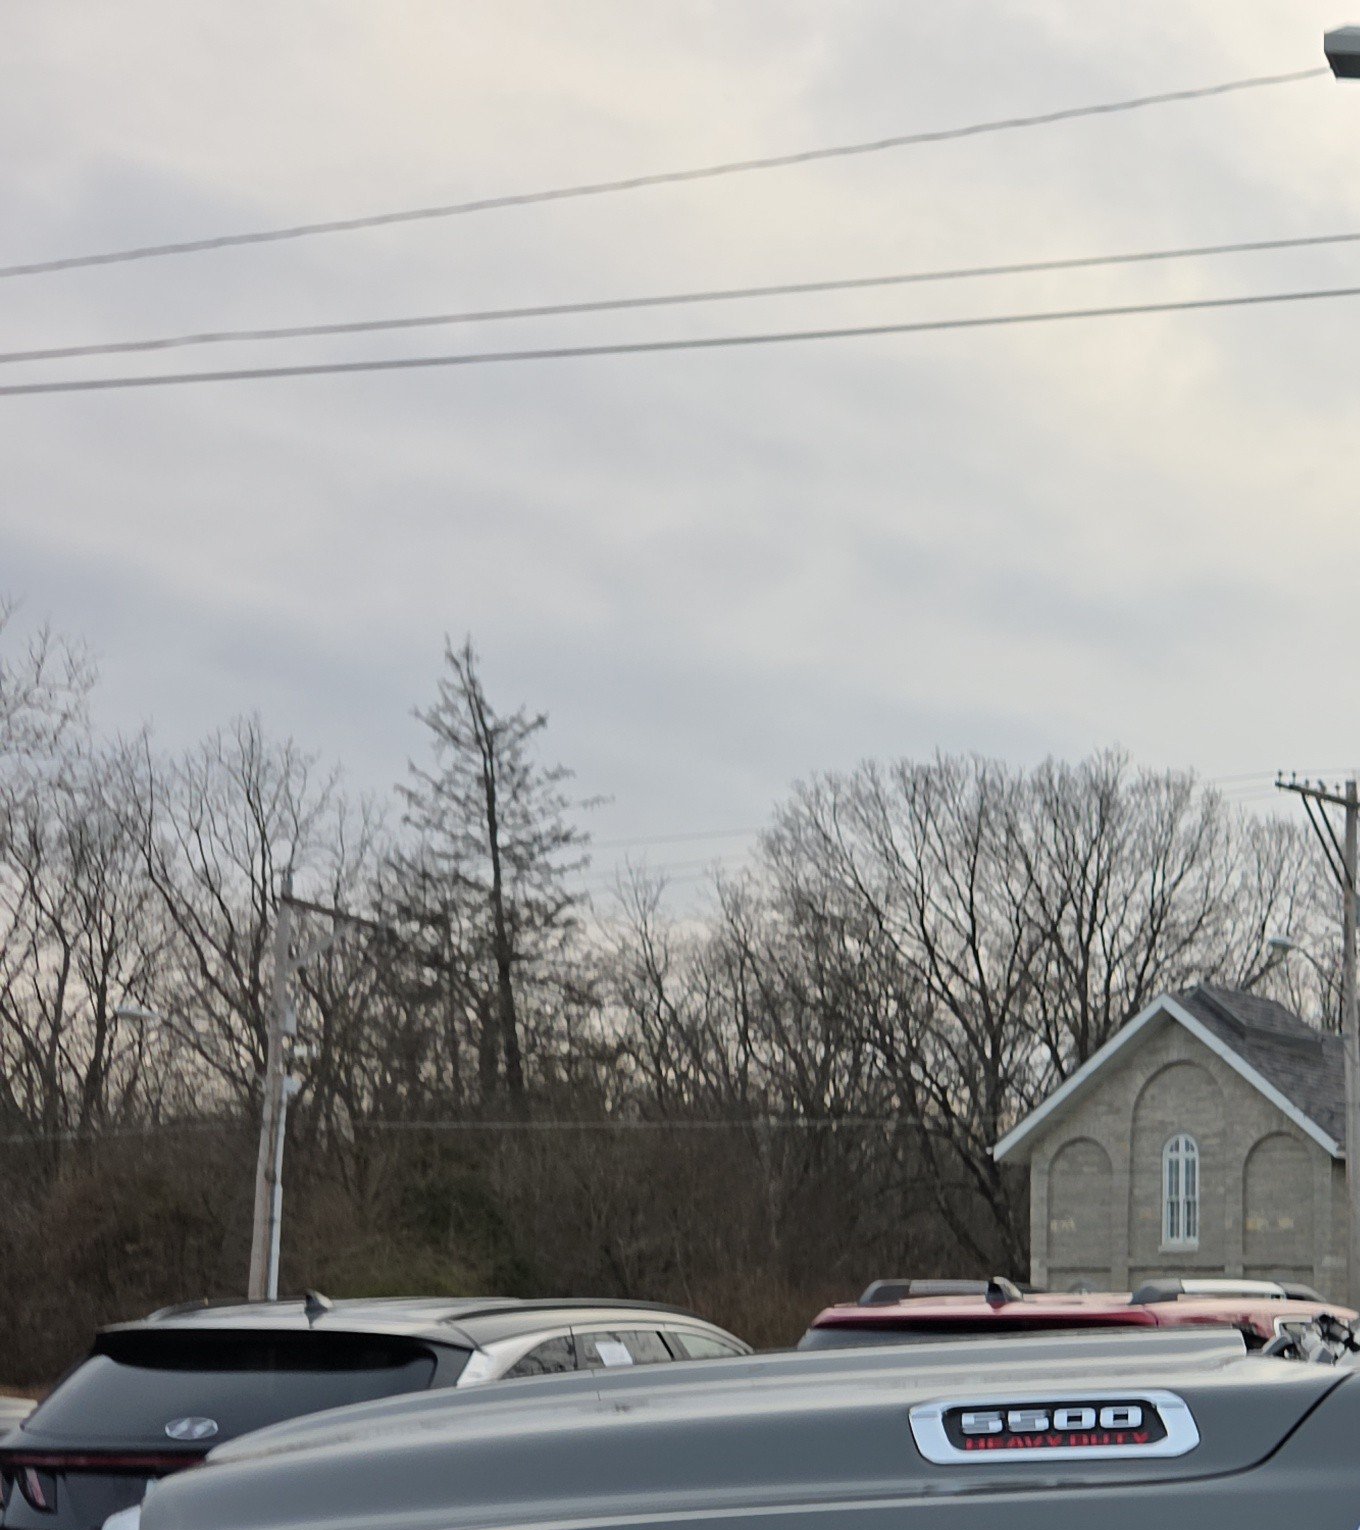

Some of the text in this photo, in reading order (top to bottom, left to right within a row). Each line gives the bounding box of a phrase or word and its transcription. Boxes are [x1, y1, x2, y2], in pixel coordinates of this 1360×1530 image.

[961, 1406, 1143, 1435] 5500
[965, 1431, 1148, 1450] HEAVY DUTY
